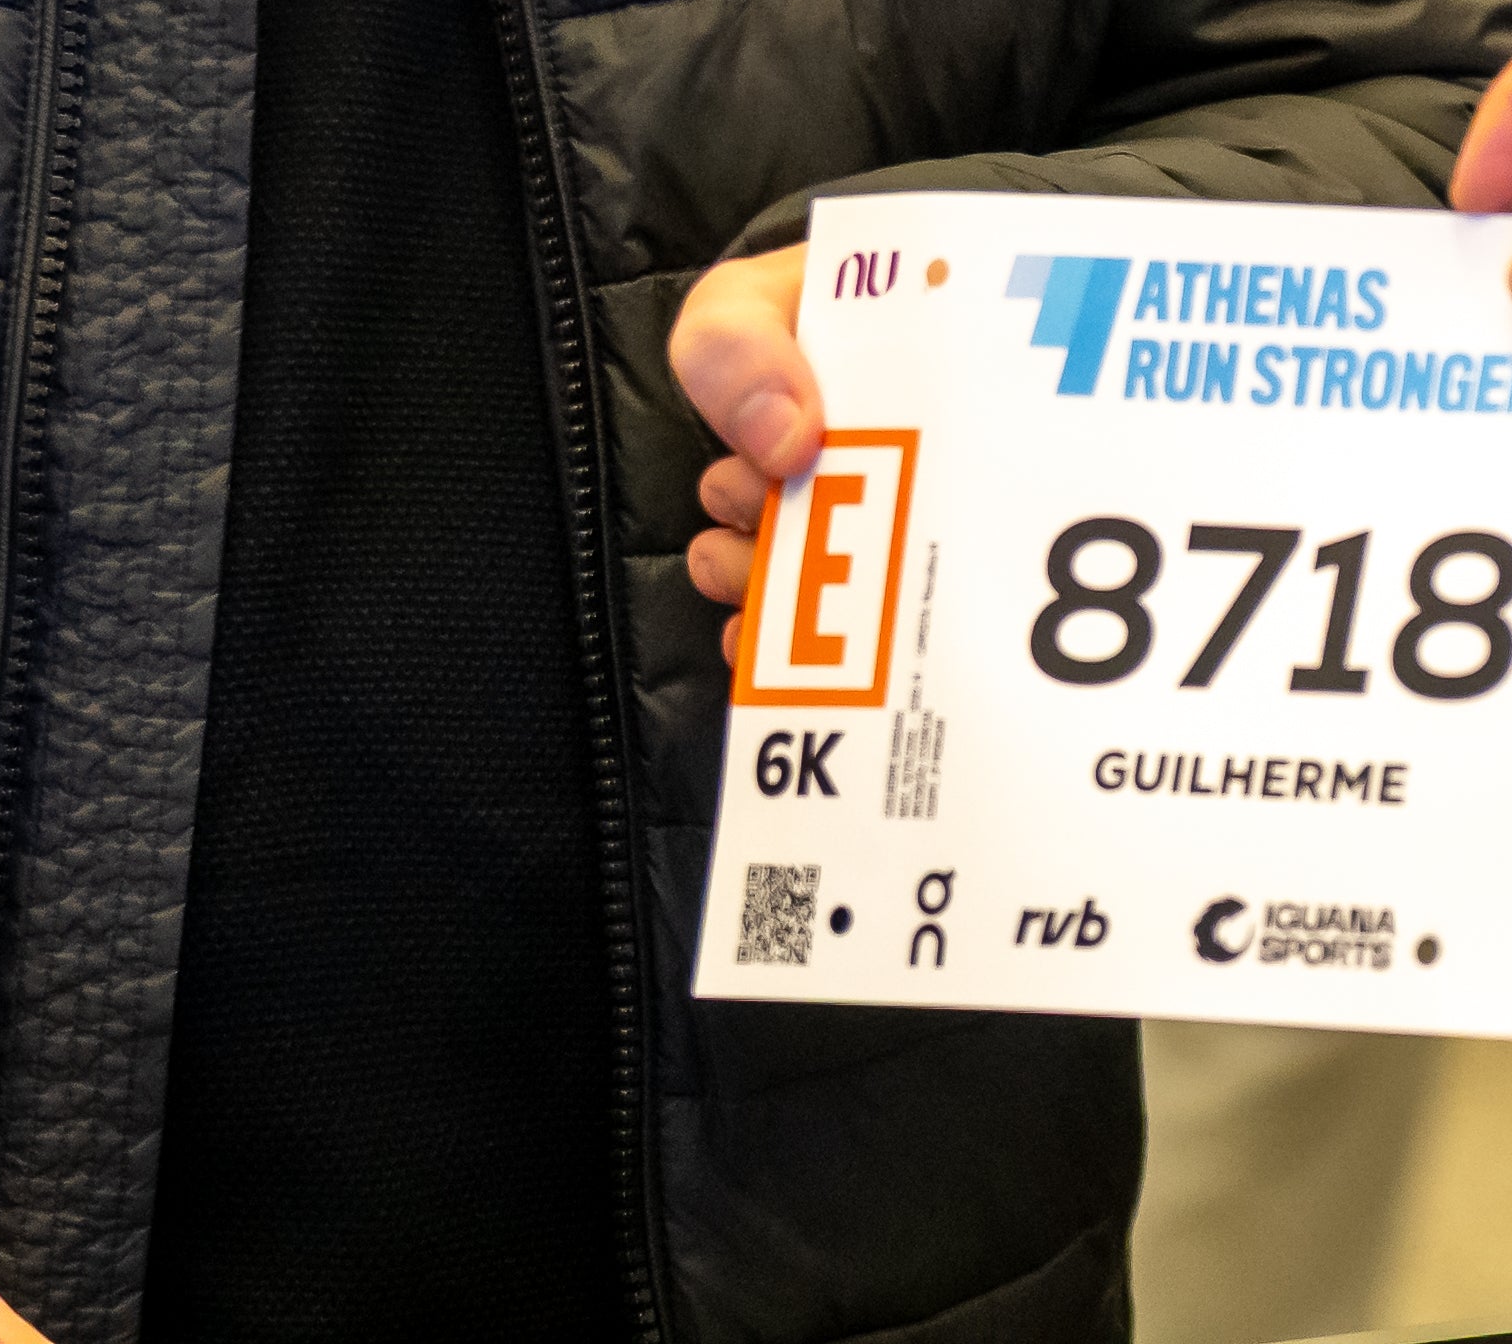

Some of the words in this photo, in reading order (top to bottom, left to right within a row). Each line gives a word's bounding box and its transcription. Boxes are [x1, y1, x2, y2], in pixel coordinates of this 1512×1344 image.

[1132, 259, 1390, 331] ATHENAS
[1123, 339, 1239, 402] RUN
[789, 474, 867, 666] E
[755, 730, 845, 798] 6K
[1093, 751, 1408, 806] GUILHERME
[1262, 901, 1395, 937] IGUANA
[1258, 934, 1392, 970] SPORTS
